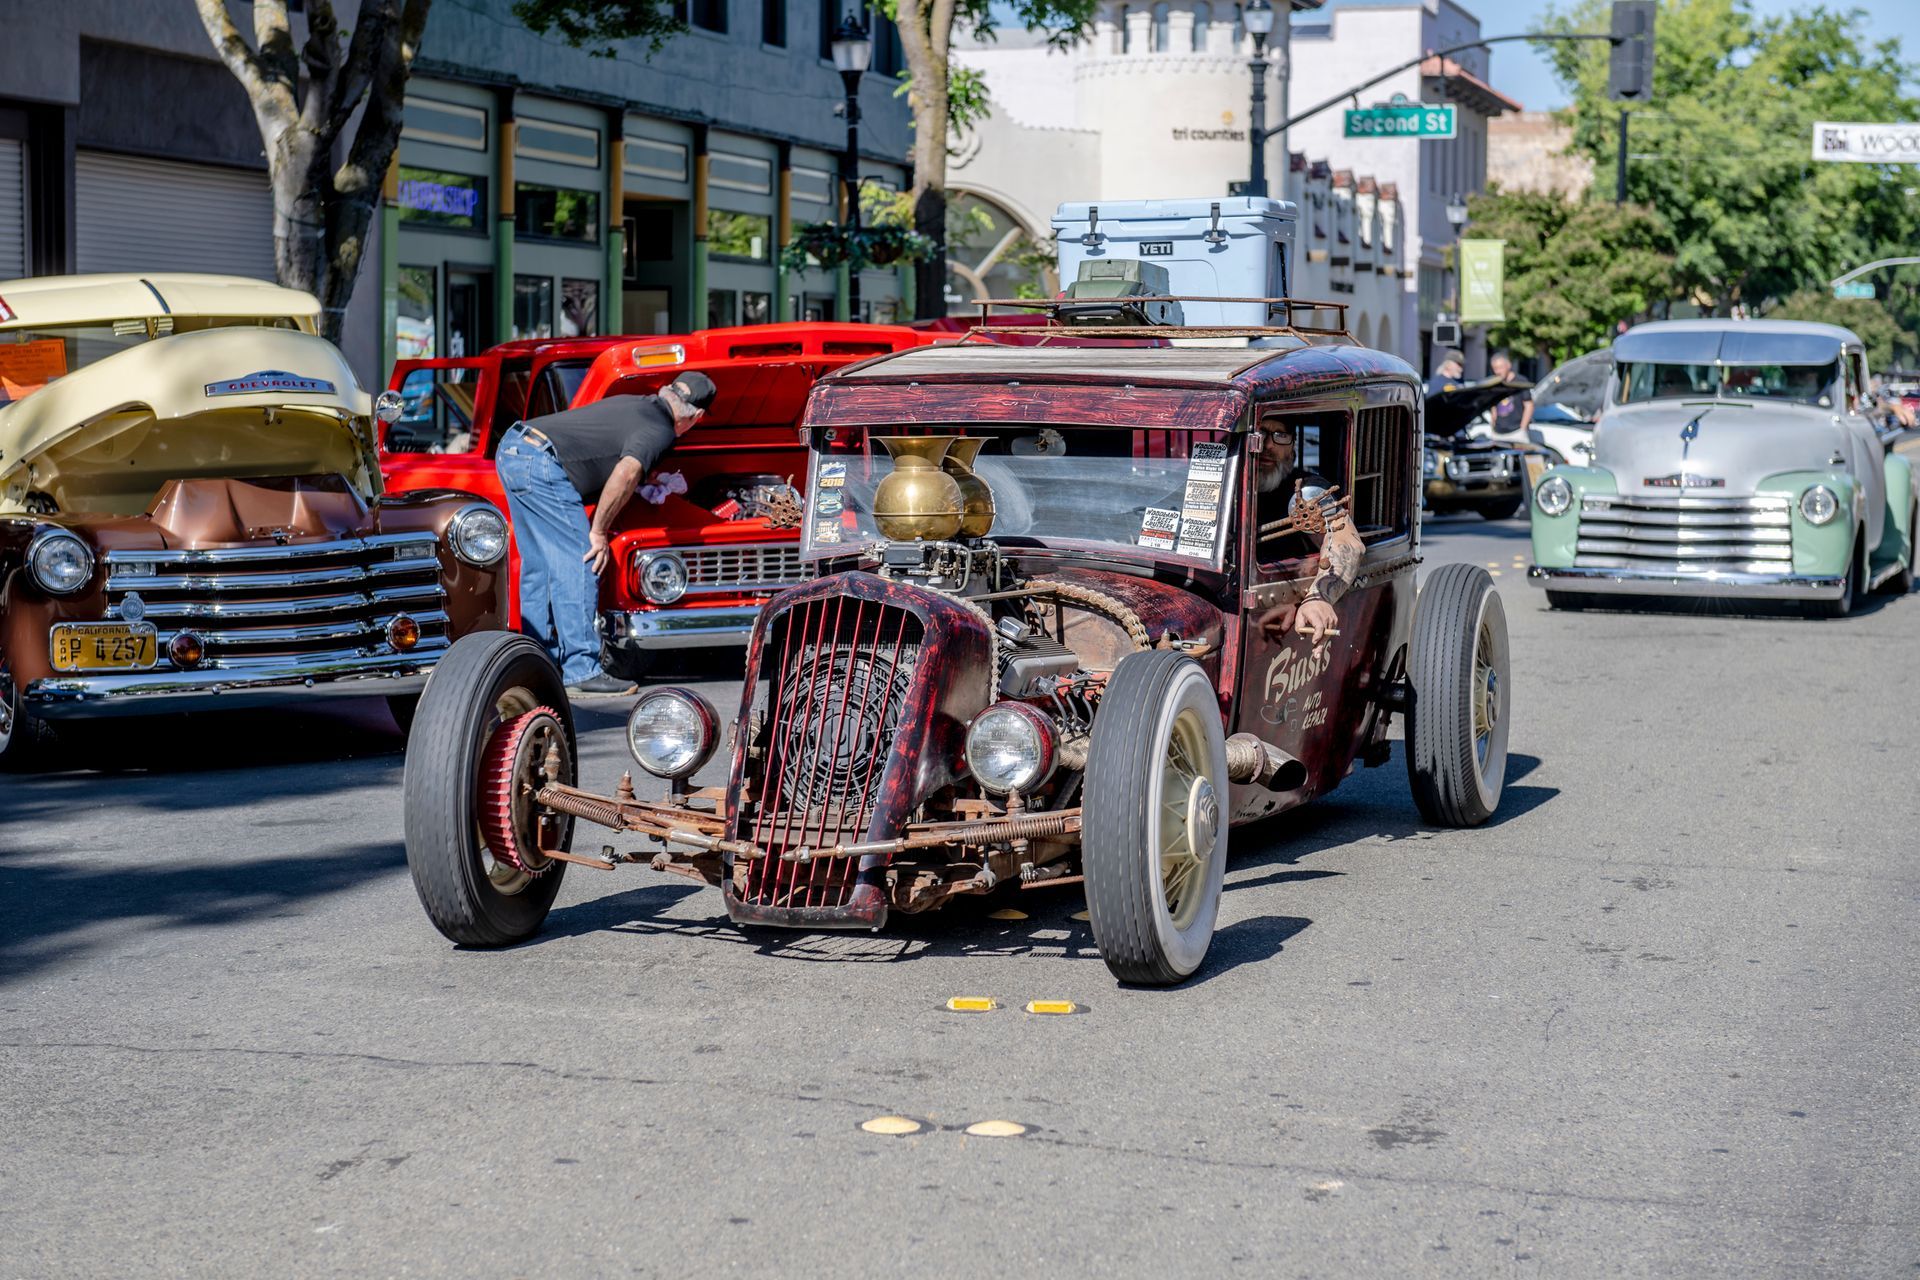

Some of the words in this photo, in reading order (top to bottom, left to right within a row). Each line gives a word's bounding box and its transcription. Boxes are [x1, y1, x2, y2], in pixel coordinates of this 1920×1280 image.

[1351, 113, 1420, 132] Second
[1425, 112, 1448, 131] St
[1173, 128, 1188, 141] tri
[1190, 129, 1244, 141] counties
[1141, 244, 1172, 254] YETI
[228, 380, 317, 390] CHEVROLET
[1146, 508, 1178, 519] WOODLAND
[1150, 515, 1173, 523] STREET
[1144, 520, 1174, 531] CRUISERS
[1184, 518, 1217, 527] WOODLAND
[1188, 524, 1211, 532] STREET
[1182, 529, 1212, 540] CRUISERS
[78, 627, 130, 635] CALIFORNIA
[1302, 691, 1323, 711] AUTO
[1302, 707, 1328, 730] REPAIR
